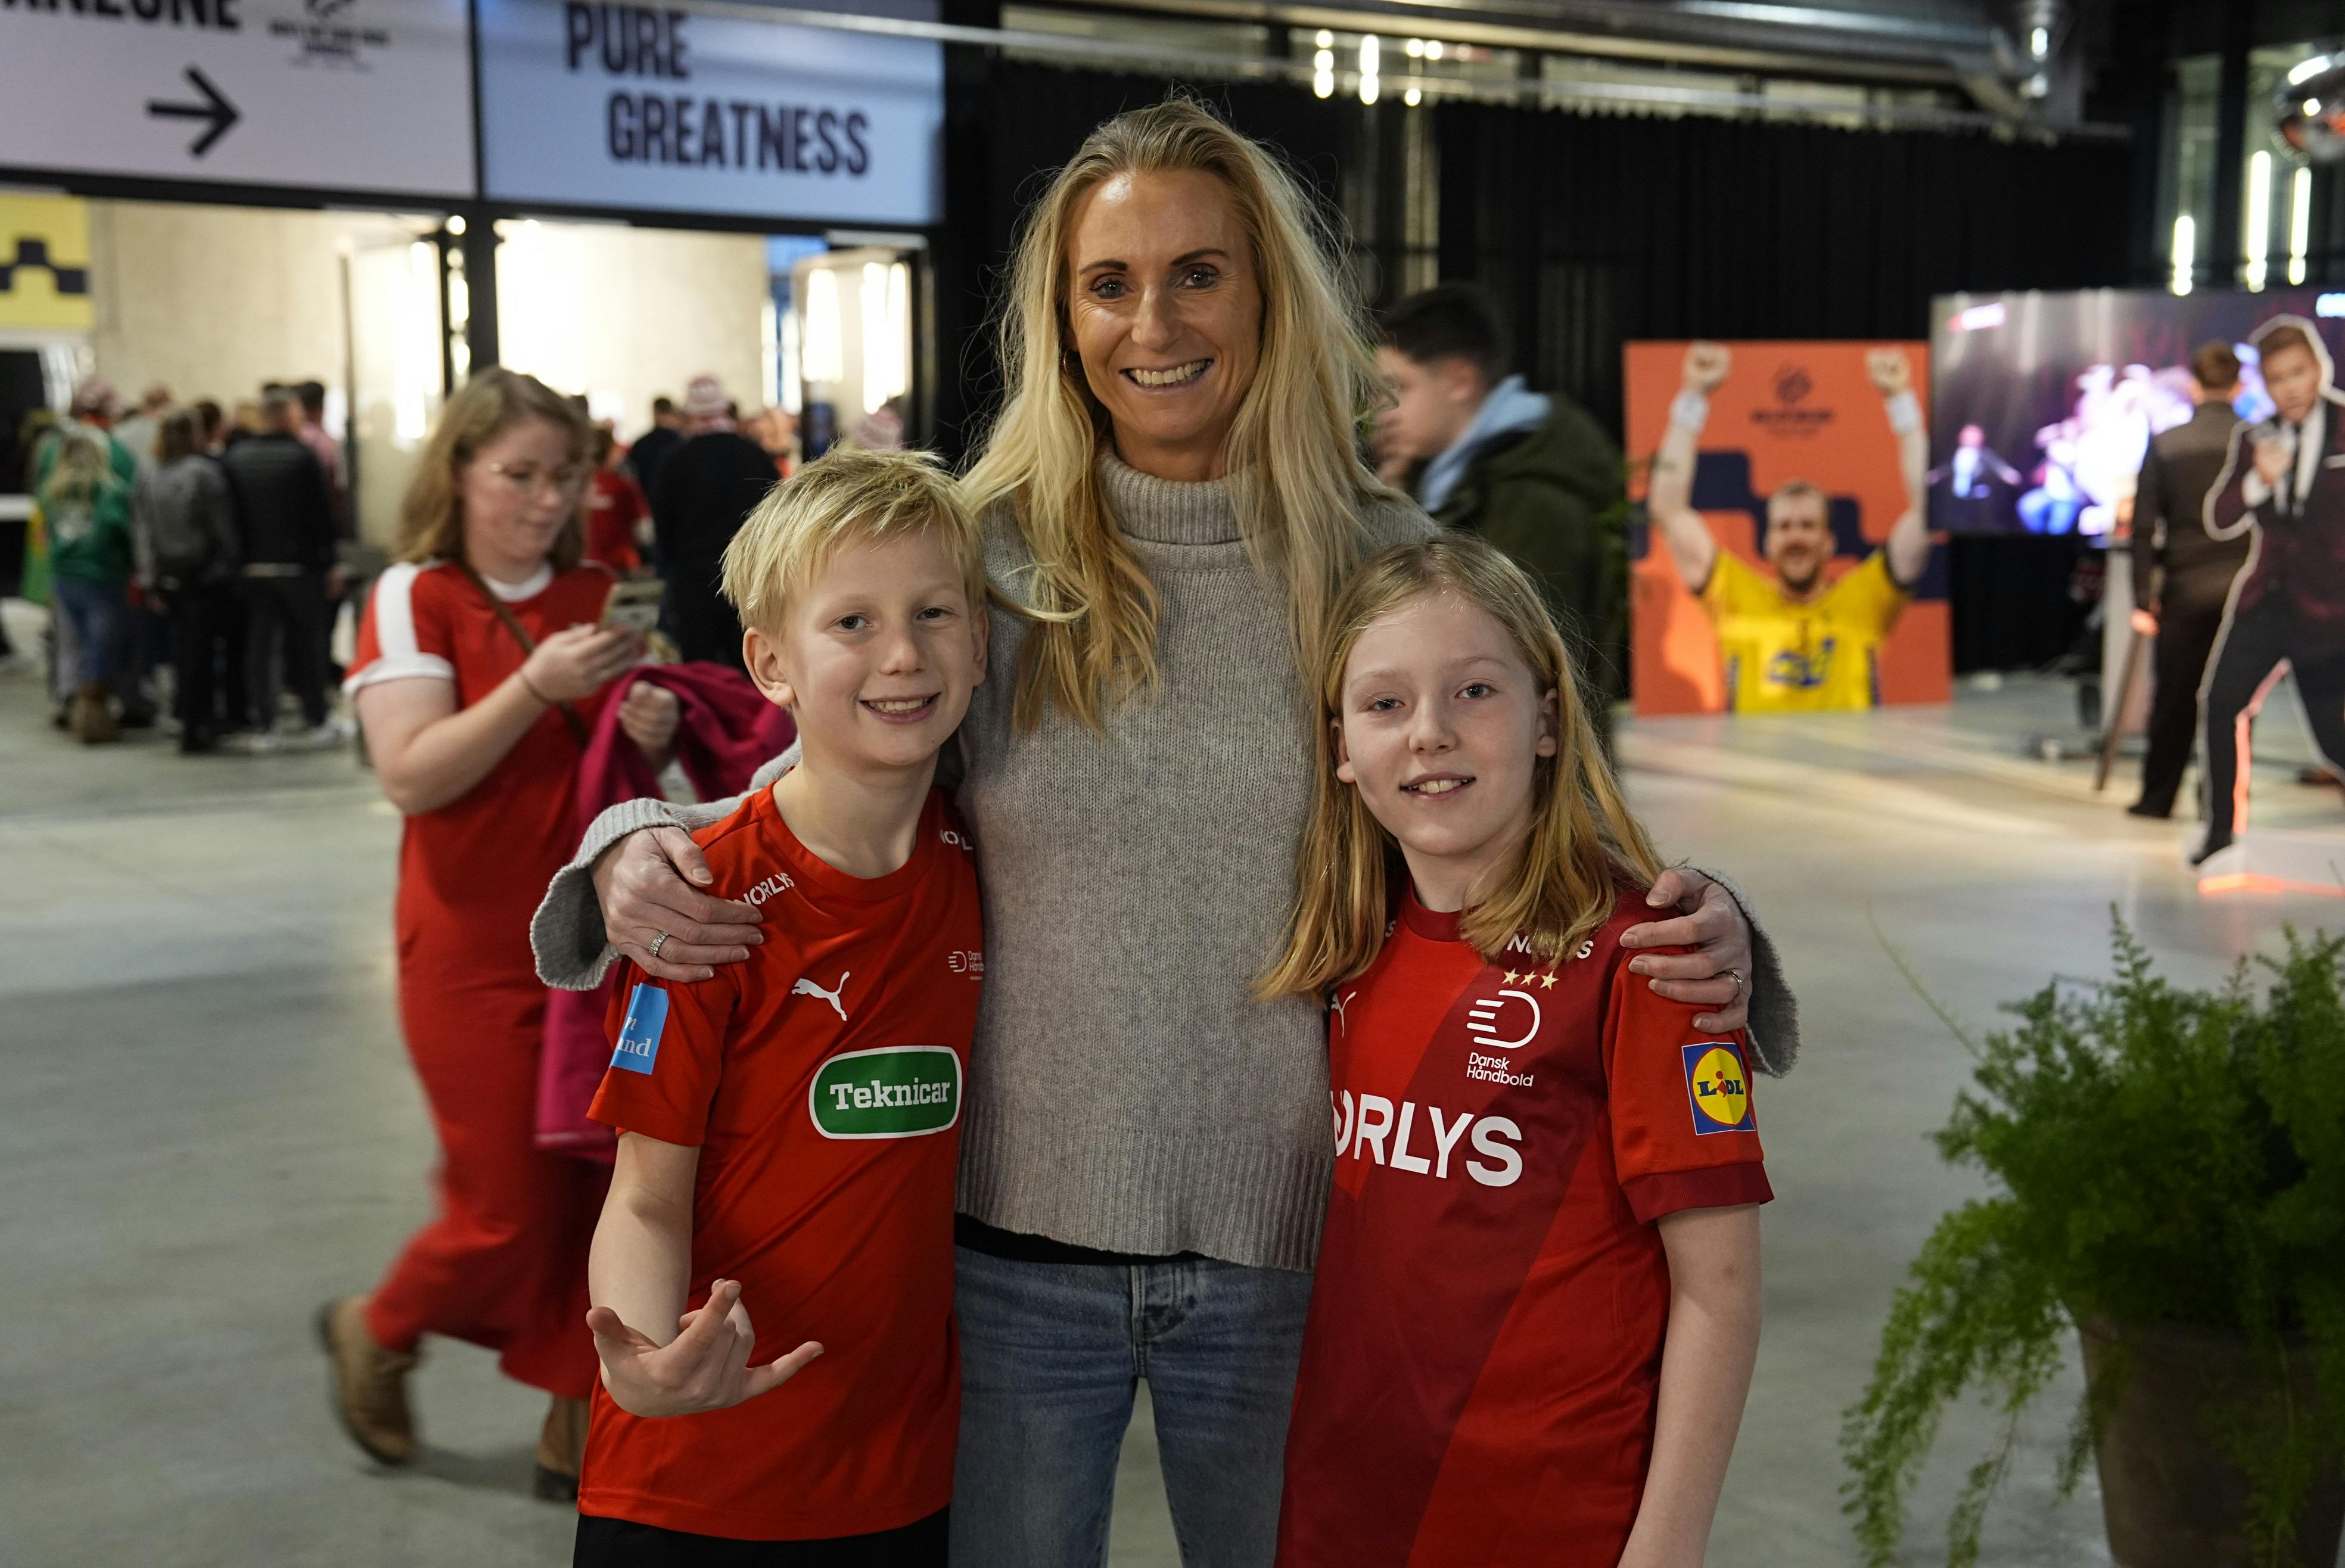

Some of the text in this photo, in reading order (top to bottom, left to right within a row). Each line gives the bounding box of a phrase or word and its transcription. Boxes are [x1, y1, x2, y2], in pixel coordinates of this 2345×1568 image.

[567, 1, 689, 78] PURE
[608, 92, 869, 175] GREATNESS
[1466, 1065, 1534, 1087] Håndbold
[1469, 1051, 1510, 1071] Dansk
[830, 1077, 950, 1110] Teknicar
